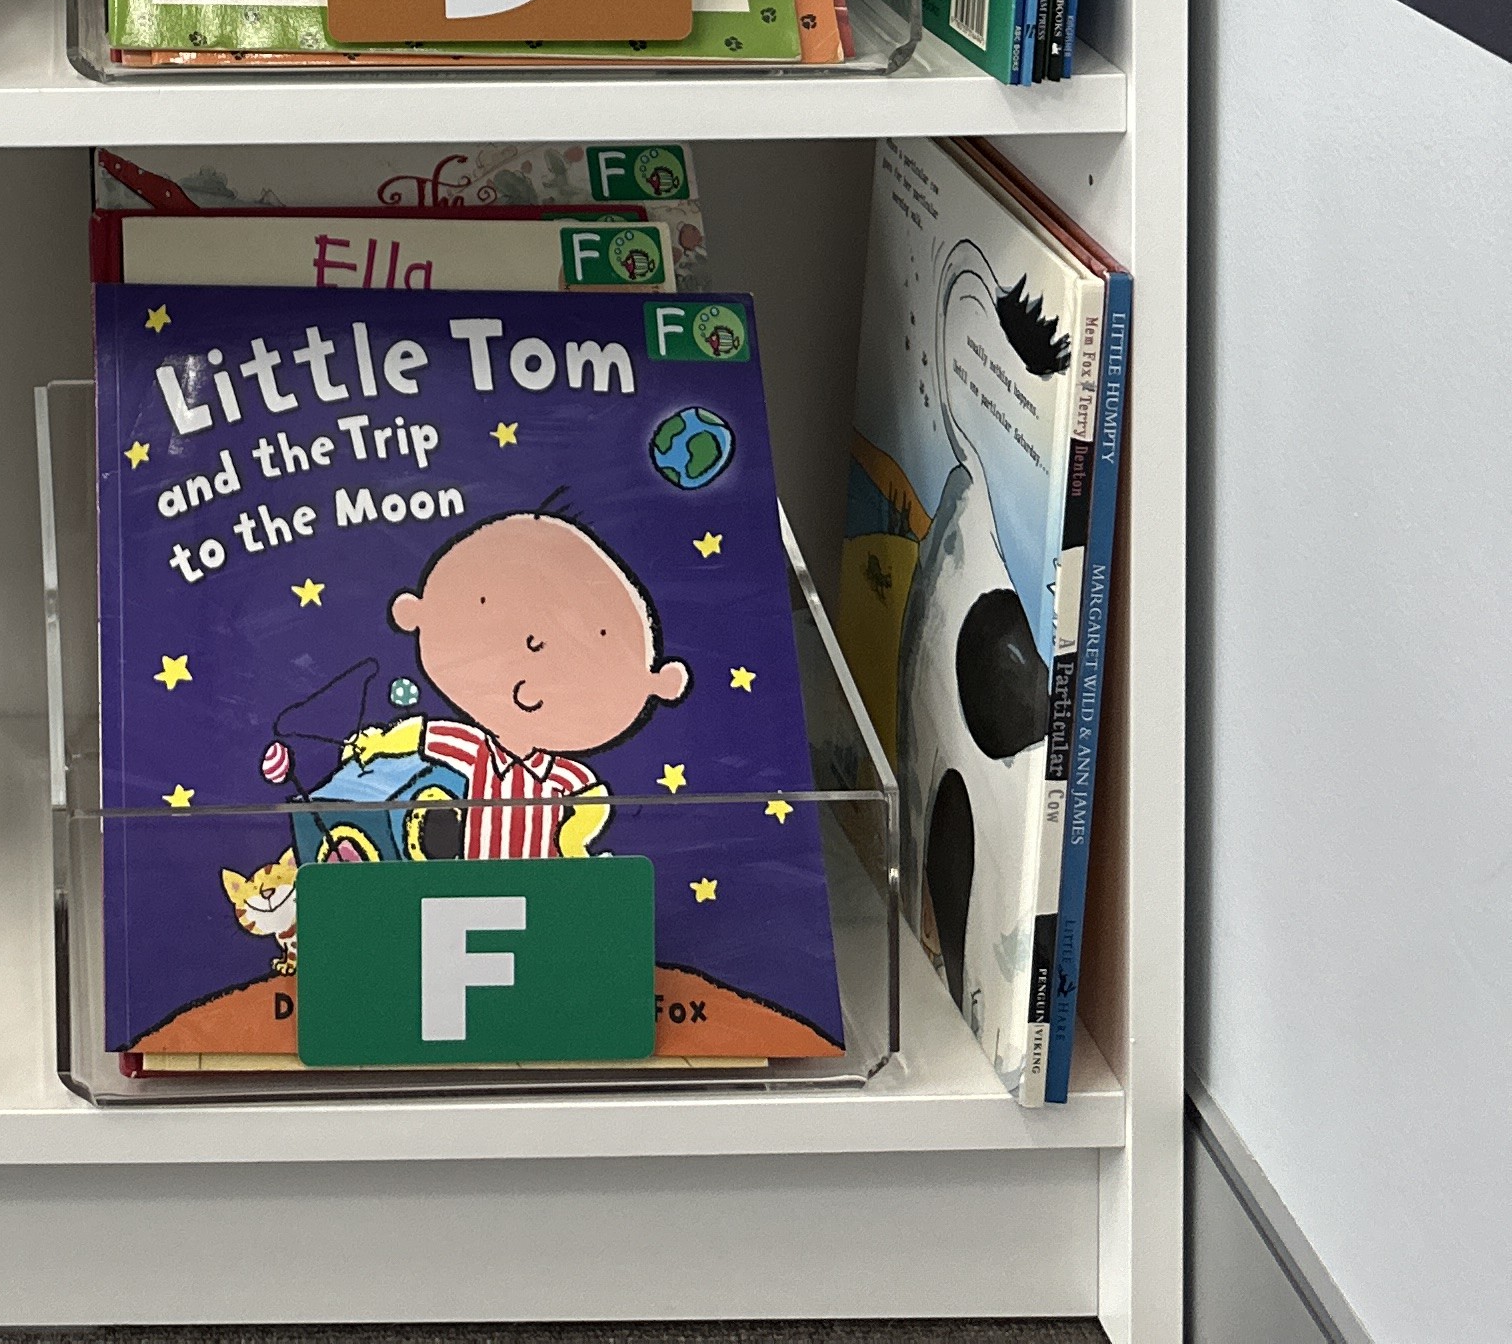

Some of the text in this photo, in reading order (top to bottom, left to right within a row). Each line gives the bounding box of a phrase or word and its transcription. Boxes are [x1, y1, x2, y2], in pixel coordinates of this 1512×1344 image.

[598, 151, 626, 197] F
[313, 234, 433, 290] Ella
[573, 233, 600, 280] F
[155, 318, 636, 435] Little Tom
[655, 308, 686, 357] F
[1070, 317, 1098, 496] Mem Fox Terry Denton
[1100, 312, 1126, 465] LITTLE HUMPTY
[157, 415, 439, 518] and the Trip
[169, 483, 465, 584] to the Moon
[1070, 563, 1106, 845] MARGARET WILD & ANN JAMES
[421, 896, 527, 1041] F
[656, 995, 707, 1024] Fox
